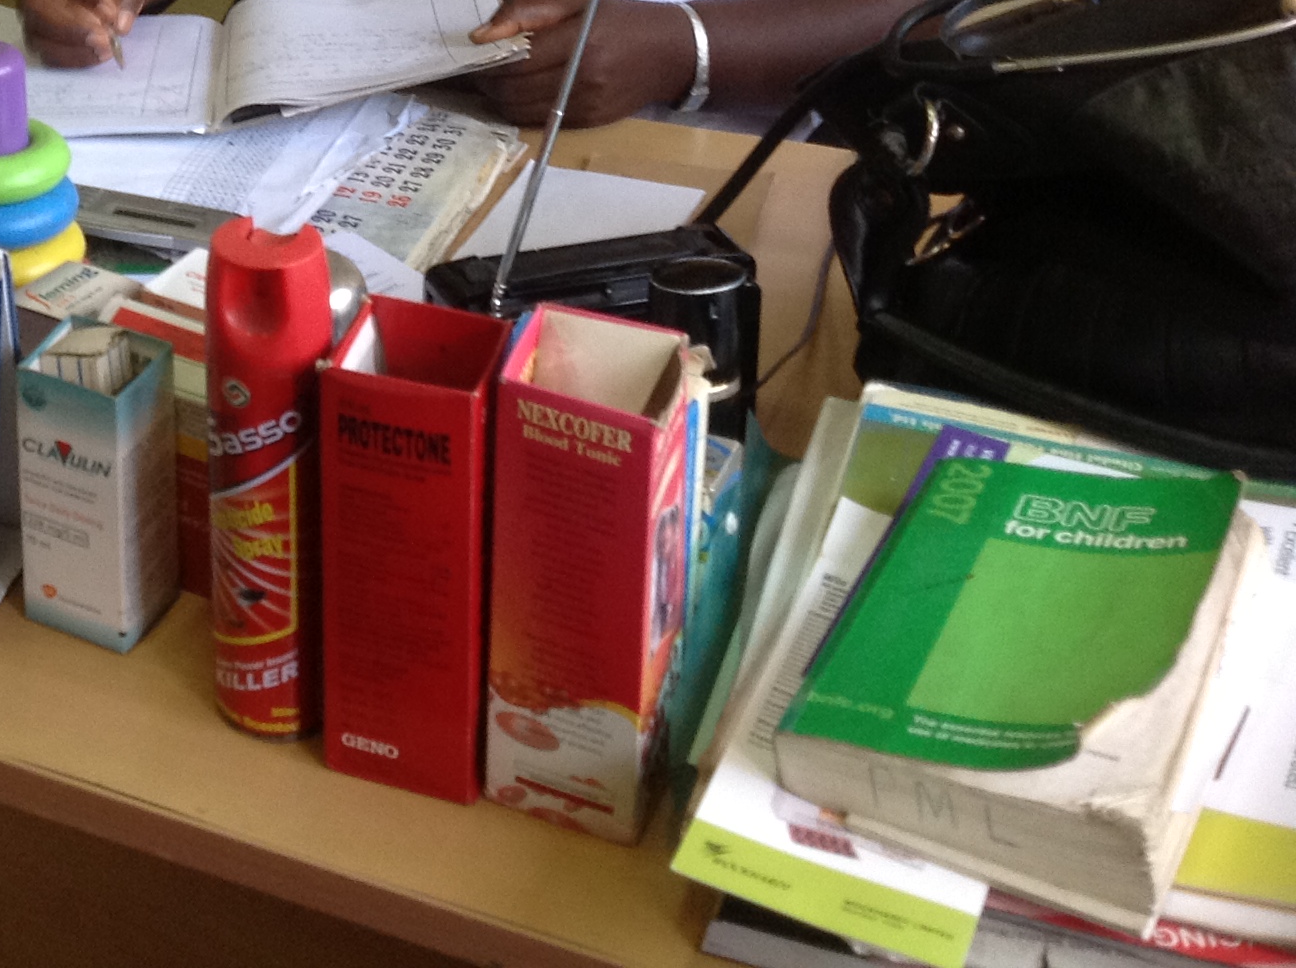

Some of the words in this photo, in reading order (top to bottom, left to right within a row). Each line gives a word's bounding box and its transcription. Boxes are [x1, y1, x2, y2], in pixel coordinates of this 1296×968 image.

[444, 126, 467, 137] 31
[406, 134, 429, 146] 23
[433, 138, 457, 151] 30
[394, 148, 418, 161] 22
[422, 152, 445, 164] 29
[382, 163, 406, 175] 21
[410, 167, 434, 179] 28
[371, 175, 395, 188] 20
[399, 180, 423, 194] 27
[333, 185, 356, 198] 12
[359, 191, 382, 203] 19
[386, 195, 412, 209] 26
[517, 398, 633, 453] NEXCOFER
[337, 413, 452, 467] PROTECTONE
[522, 424, 569, 452] Blood
[575, 439, 622, 467] Tonic
[22, 438, 112, 478] CLAVULIN
[927, 462, 993, 525] 2007
[1012, 493, 1157, 532] BNF
[1004, 520, 1051, 541] for
[1054, 528, 1189, 550] children
[215, 660, 299, 691] KILLER
[341, 732, 399, 760] GENO
